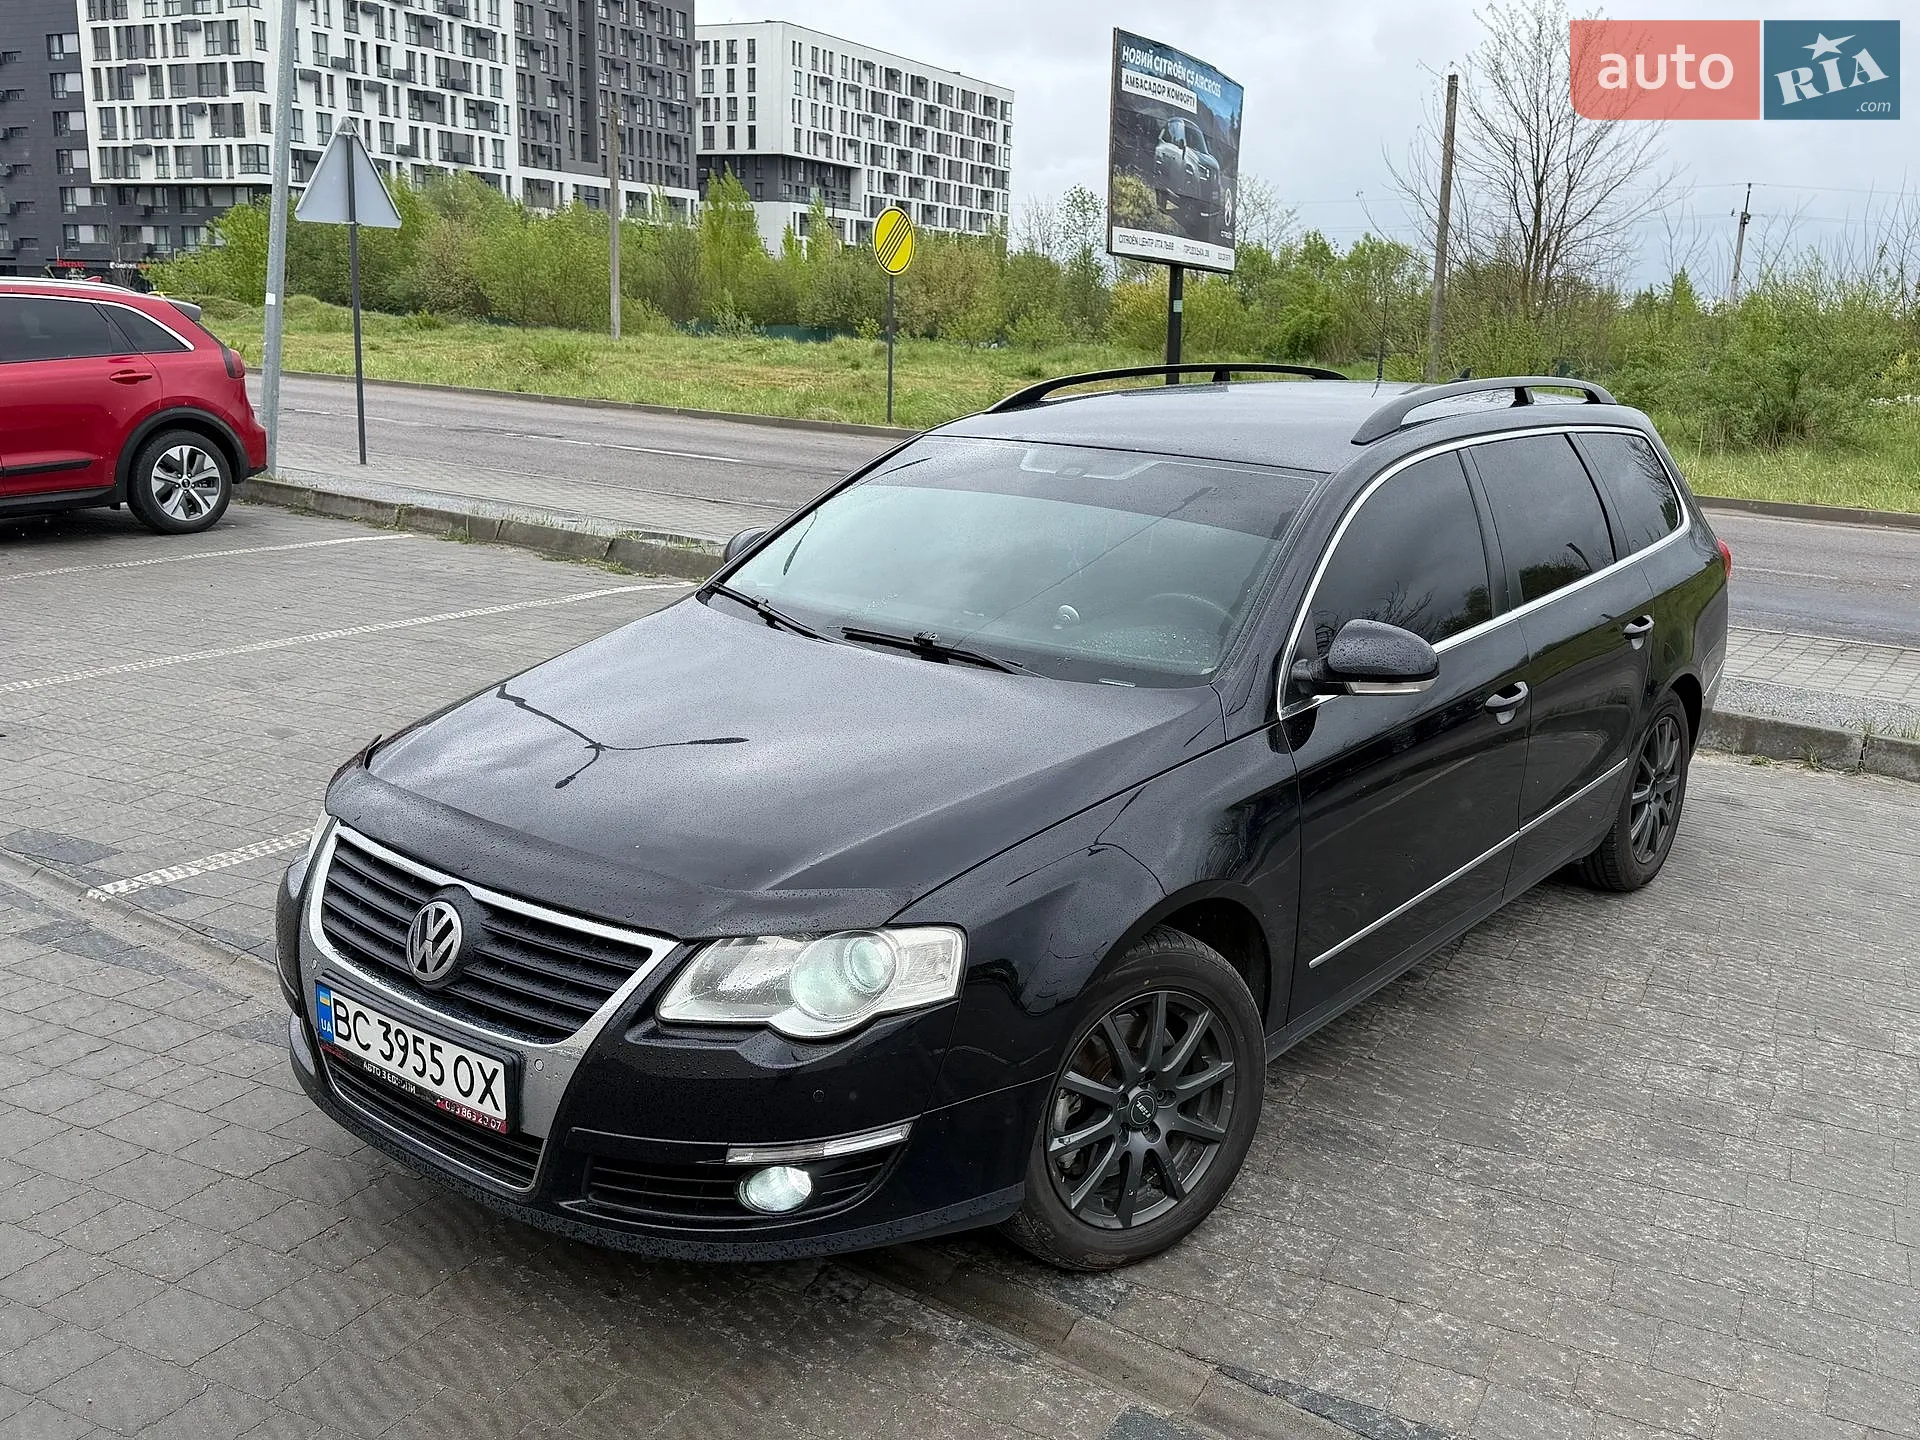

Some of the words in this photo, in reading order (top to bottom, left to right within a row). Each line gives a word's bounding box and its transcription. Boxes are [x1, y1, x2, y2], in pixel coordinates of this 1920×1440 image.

[1122, 45, 1154, 69] НОВИЙ
[1125, 74, 1166, 96] АМБАСАДОР
[321, 1018, 333, 1034] UA
[333, 997, 371, 1052] BC
[377, 1019, 445, 1087] 3955
[453, 1054, 501, 1112] OX
